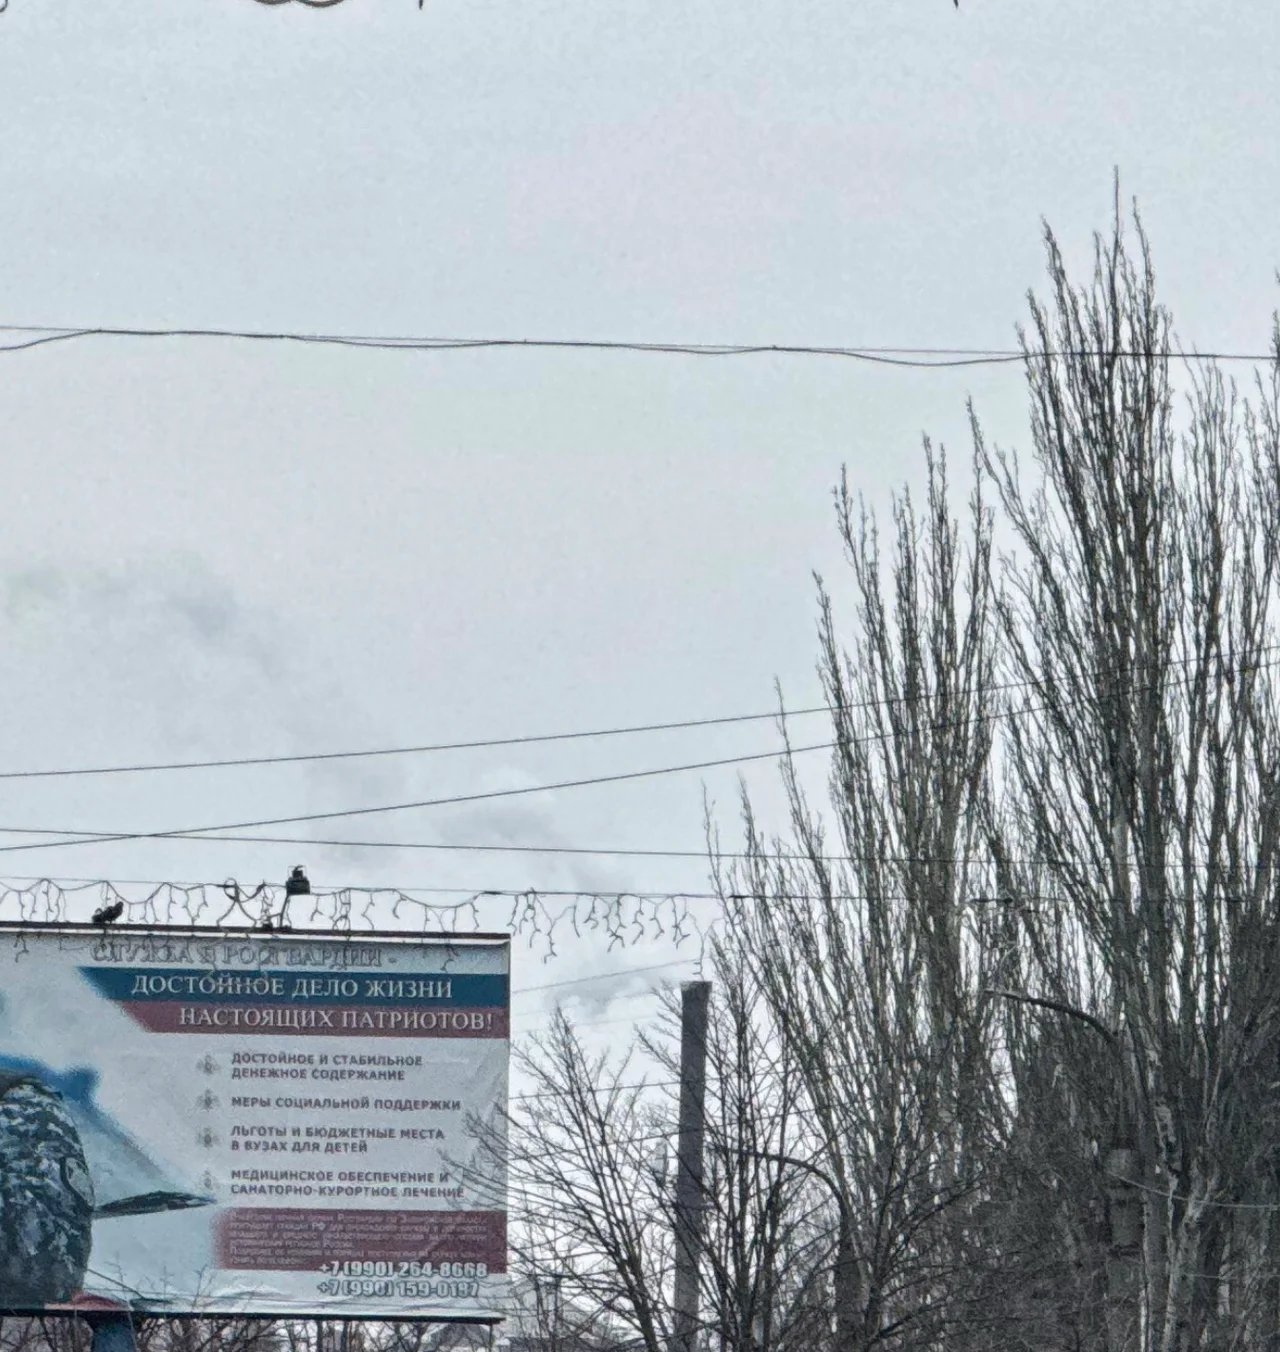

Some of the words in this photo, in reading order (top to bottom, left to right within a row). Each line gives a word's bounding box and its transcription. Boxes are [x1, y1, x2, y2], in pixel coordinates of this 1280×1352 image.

[131, 973, 284, 996] ДОСТОЙНОЕ
[291, 979, 358, 999] ДЕЛО
[365, 978, 452, 998] ЖИЗНИ
[179, 1007, 335, 1031] НАСТОЯЩИХ
[342, 1010, 492, 1031] ПАТРИОТОВ!
[231, 1052, 314, 1065] ДОСТОЙНОЕ
[320, 1054, 329, 1065] И
[333, 1054, 422, 1066] СТАБИЛЬНОЕ
[231, 1068, 307, 1080] ДЕНЕЖНОЕ
[312, 1069, 405, 1082] СОДЕРЖАНИЕ
[231, 1097, 270, 1108] МЕРЫ
[275, 1096, 370, 1110] СОЦИАЛЬНОЙ
[374, 1099, 461, 1112] ПОДДЕРЖКИ
[230, 1125, 286, 1137] ЛЬГОТЫ
[292, 1127, 301, 1137] И
[306, 1127, 396, 1140] БЮДЖЕТНЫЕ
[400, 1128, 445, 1140] МЕСТА
[231, 1140, 239, 1151] В
[245, 1140, 287, 1151] ВУЗАХ
[291, 1141, 320, 1153] ДЛЯ
[325, 1140, 368, 1154] ДЕТЕЙ
[231, 1169, 333, 1182] МЕДИЦИНСКОЕ
[338, 1171, 434, 1183] ОБЕСПЕЧЕНИЕ
[231, 1184, 397, 1197] САНАТОРНО-КУРОРТНОЕ
[401, 1186, 464, 1198] ЛЕЧЕНИЕ
[343, 1261, 393, 1277] (990)
[397, 1261, 488, 1278] 264-8668
